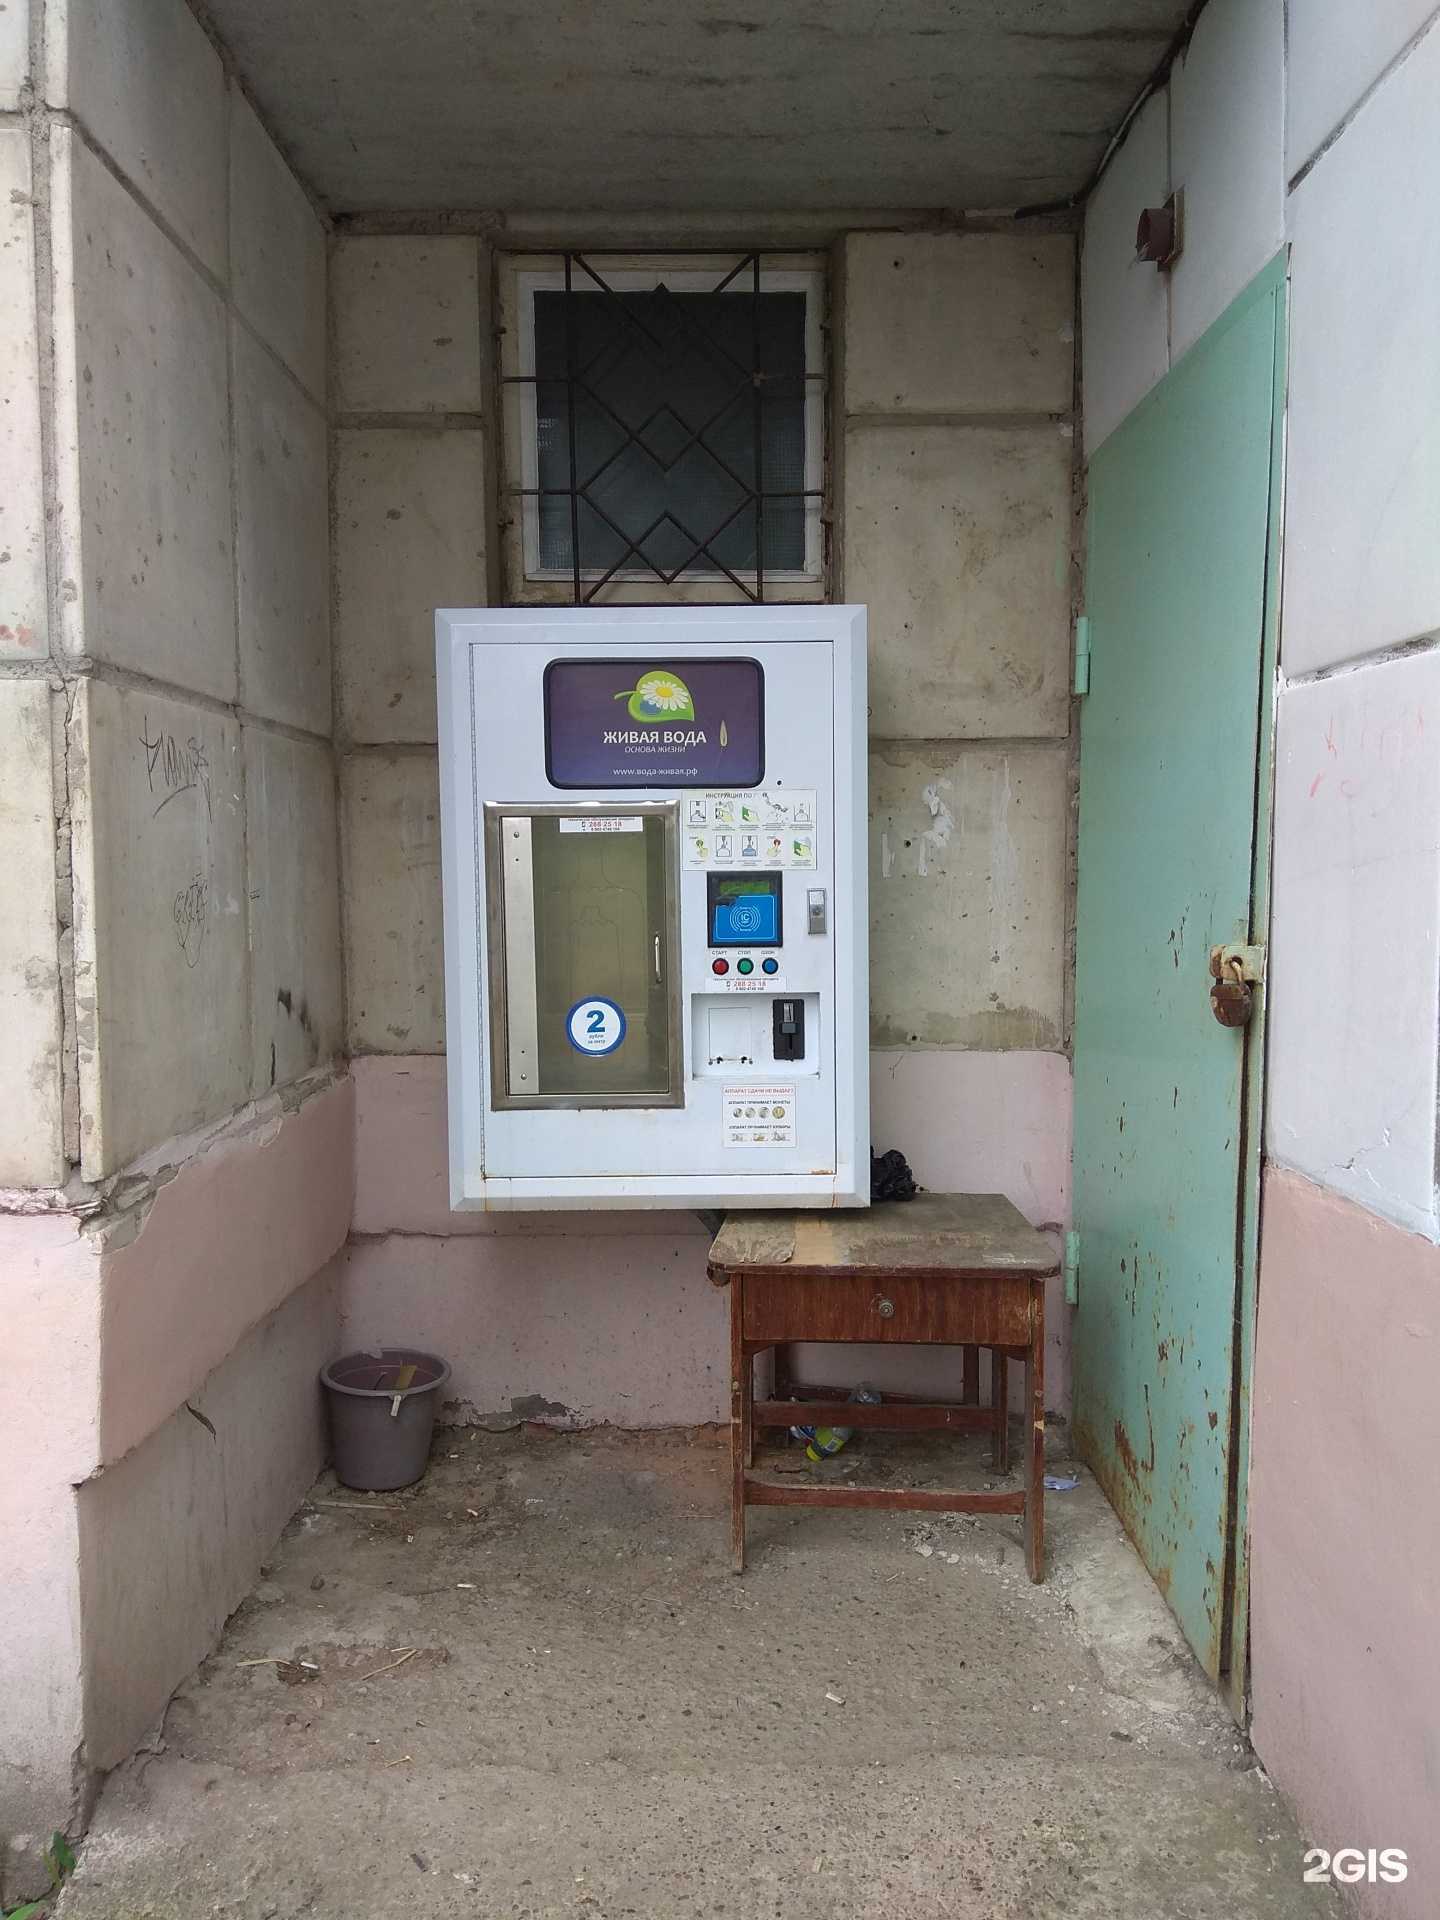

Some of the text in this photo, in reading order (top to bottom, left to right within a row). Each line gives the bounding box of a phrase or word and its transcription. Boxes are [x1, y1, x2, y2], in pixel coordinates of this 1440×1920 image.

[603, 731, 707, 746] ЖИВАЯ ВОДА
[613, 767, 698, 777] www.вода-живая.рф
[586, 1010, 606, 1033] 2
